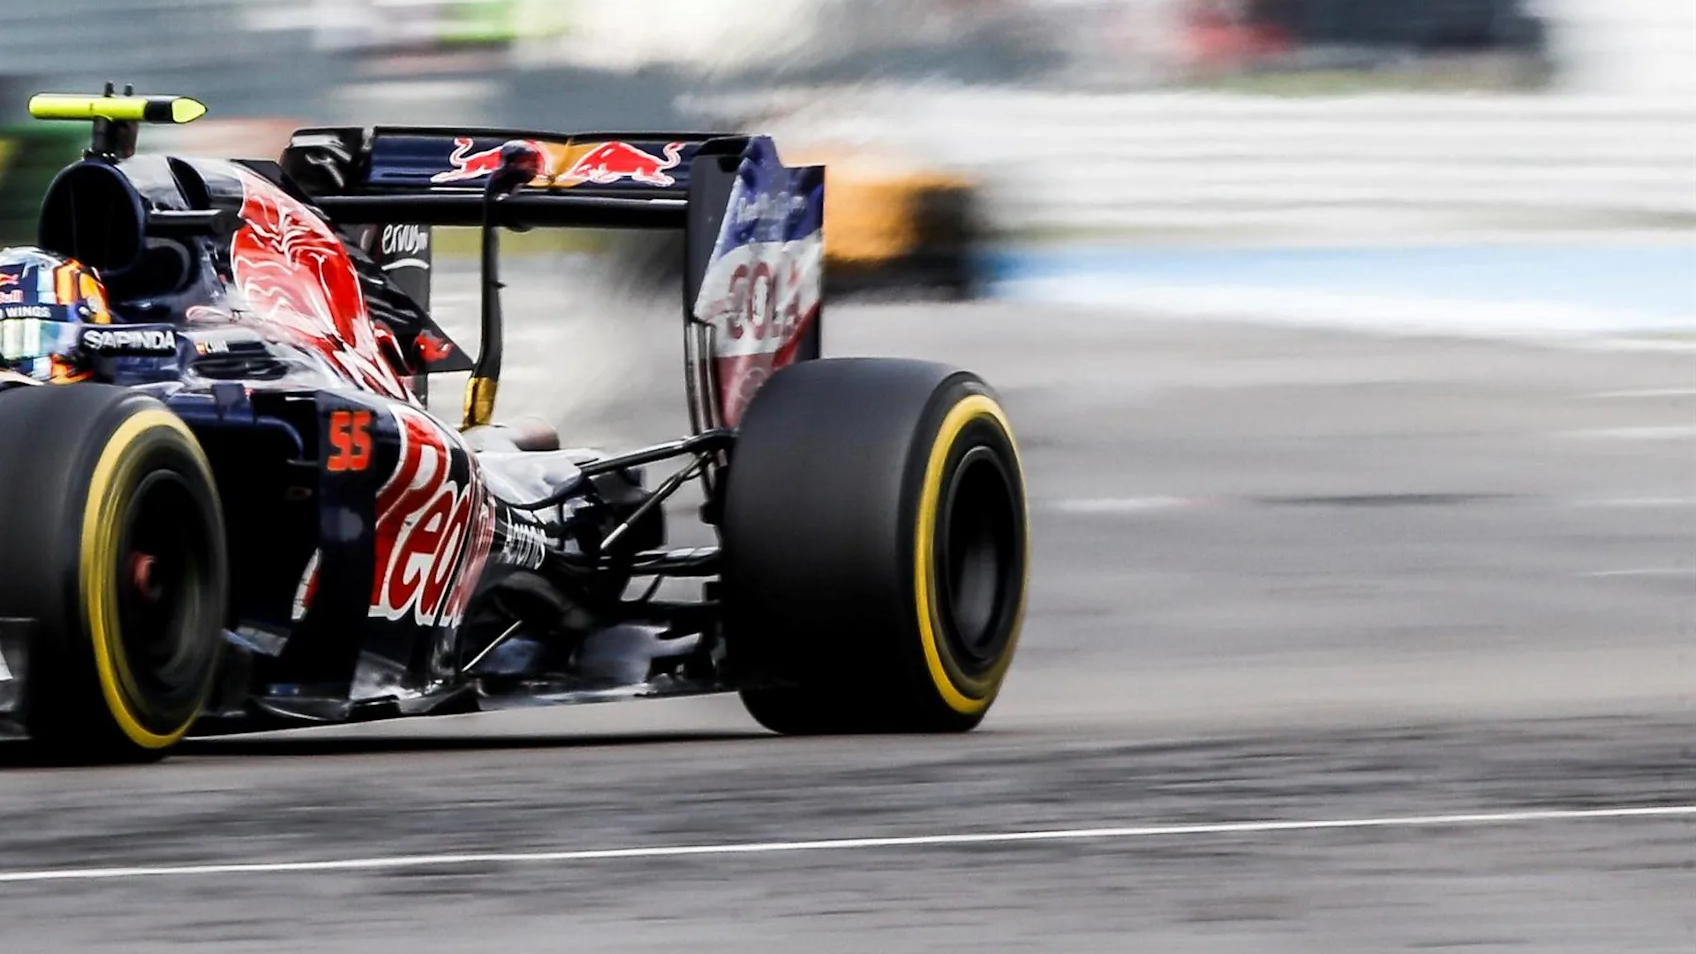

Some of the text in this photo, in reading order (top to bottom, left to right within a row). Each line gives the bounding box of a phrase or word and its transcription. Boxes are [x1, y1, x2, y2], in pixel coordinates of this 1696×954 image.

[5, 306, 52, 319] WINGS
[83, 330, 176, 350] SAPINDA
[327, 411, 372, 471] 55
